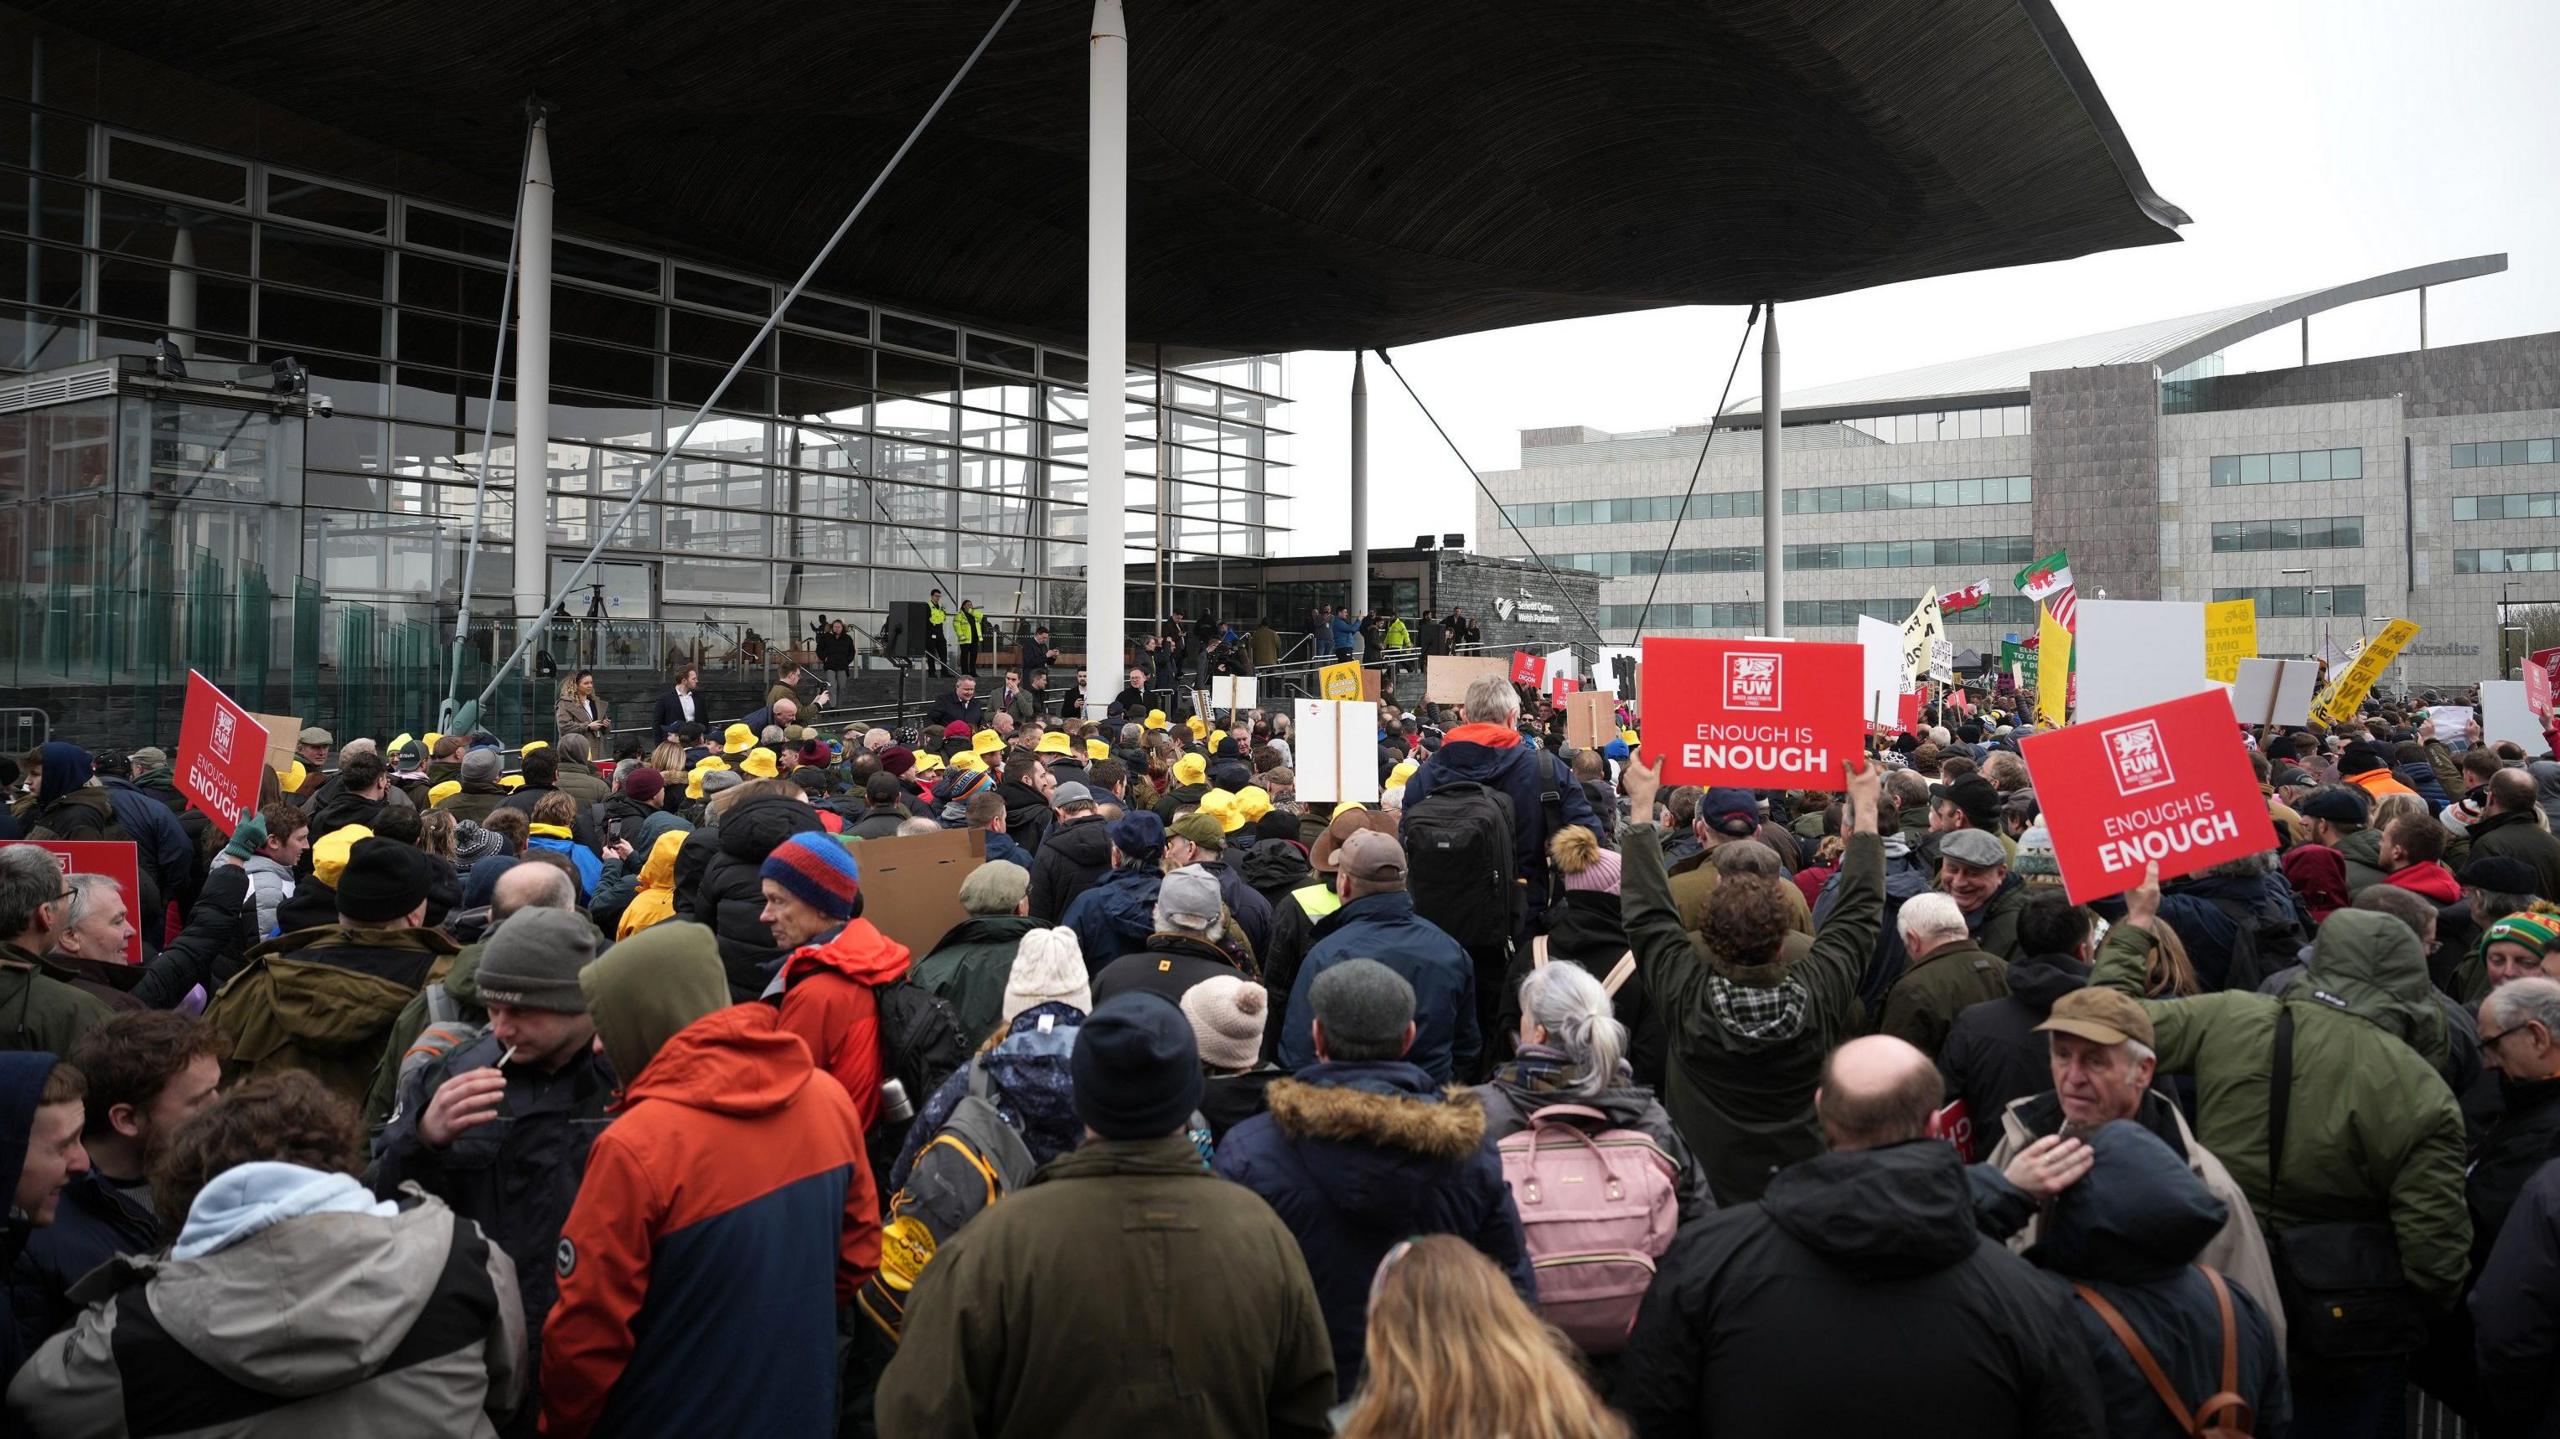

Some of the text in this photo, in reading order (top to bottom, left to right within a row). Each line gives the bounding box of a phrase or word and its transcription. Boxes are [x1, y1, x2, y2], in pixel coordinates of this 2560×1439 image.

[1732, 680, 1772, 695] FUW
[214, 728, 230, 748] FUW
[1697, 724, 1812, 744] ENOUGH IS
[1683, 744, 1827, 772] ENOUGH
[2120, 753, 2158, 776] FUW
[197, 754, 238, 799] ENOUGH IS
[188, 766, 240, 826] ENOUGH
[2104, 792, 2214, 838] ENOUGH IS
[2098, 811, 2238, 873] ENOUGH
